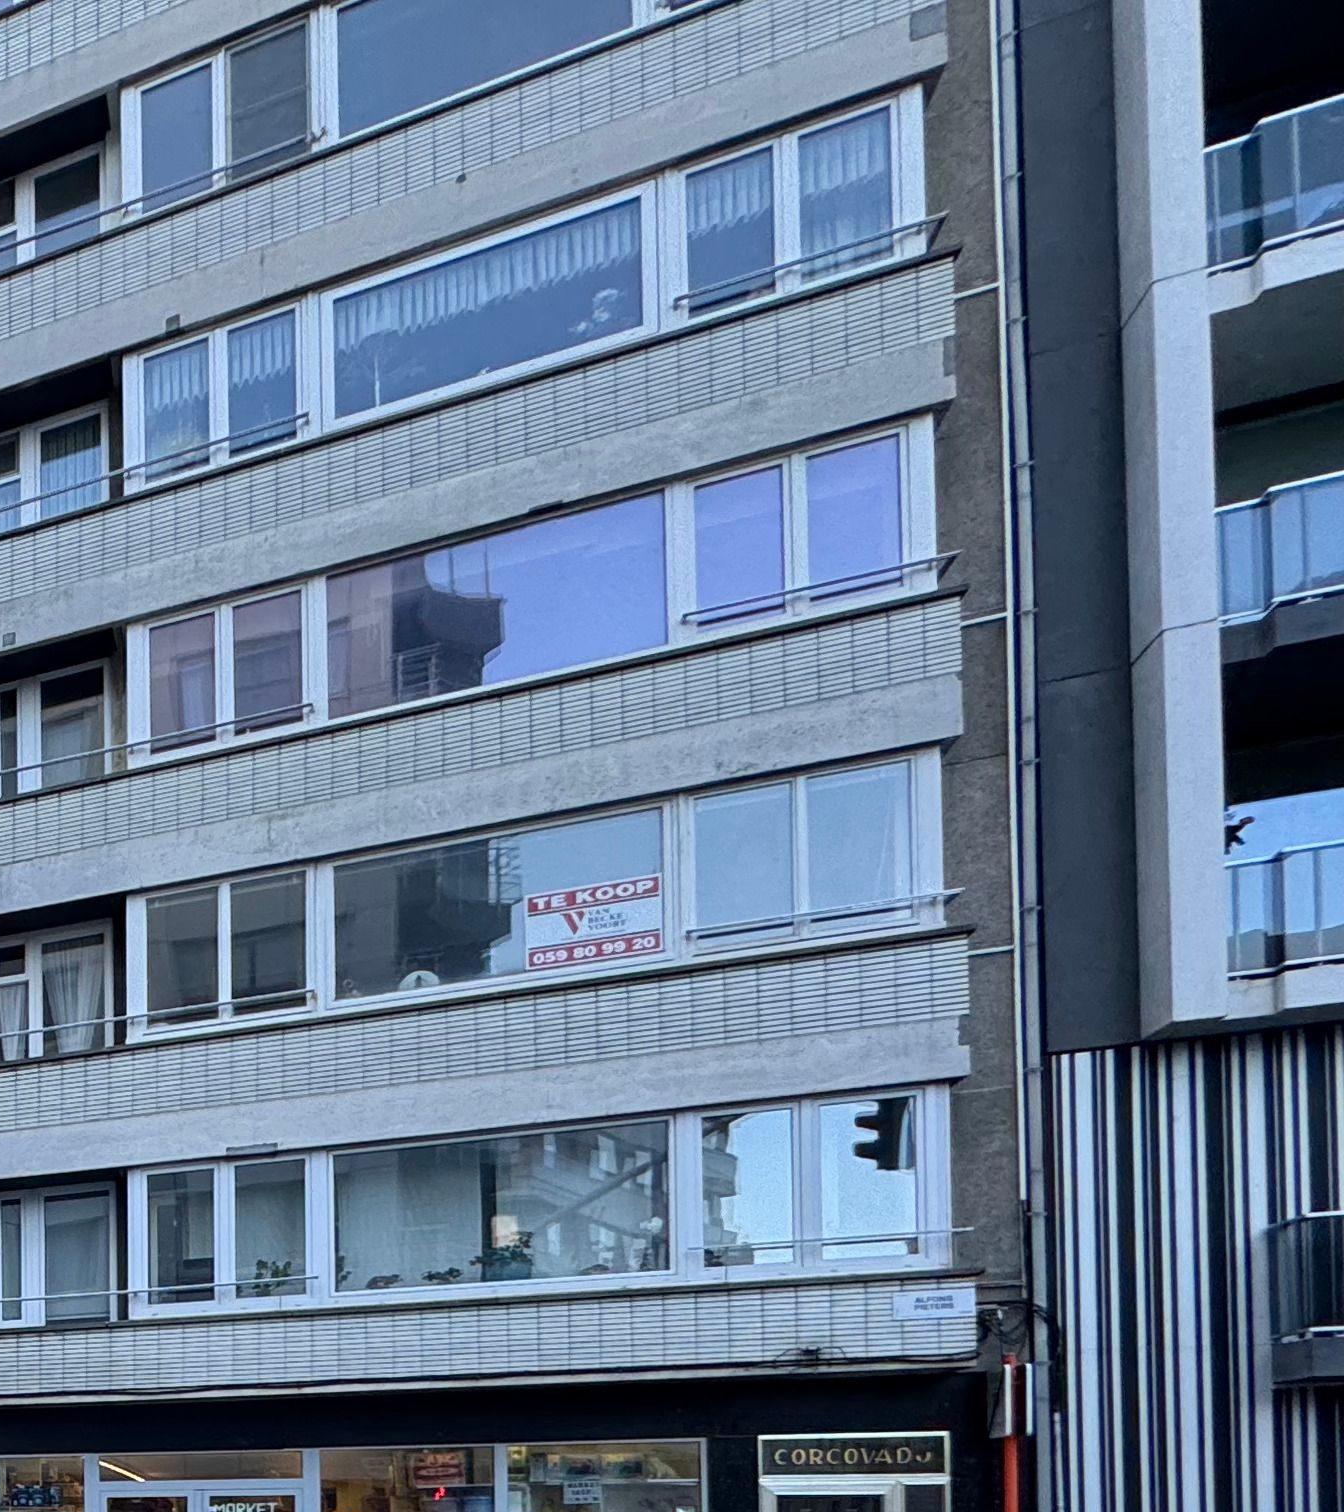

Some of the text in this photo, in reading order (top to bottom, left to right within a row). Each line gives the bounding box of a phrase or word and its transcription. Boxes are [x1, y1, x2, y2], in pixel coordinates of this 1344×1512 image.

[531, 880, 655, 910] TE KOOP
[588, 907, 611, 917] VAN
[587, 919, 627, 931] VOORT
[533, 936, 656, 965] 059 80 99 20
[915, 1295, 953, 1303] ALFONS
[913, 1302, 954, 1310] PIETERS
